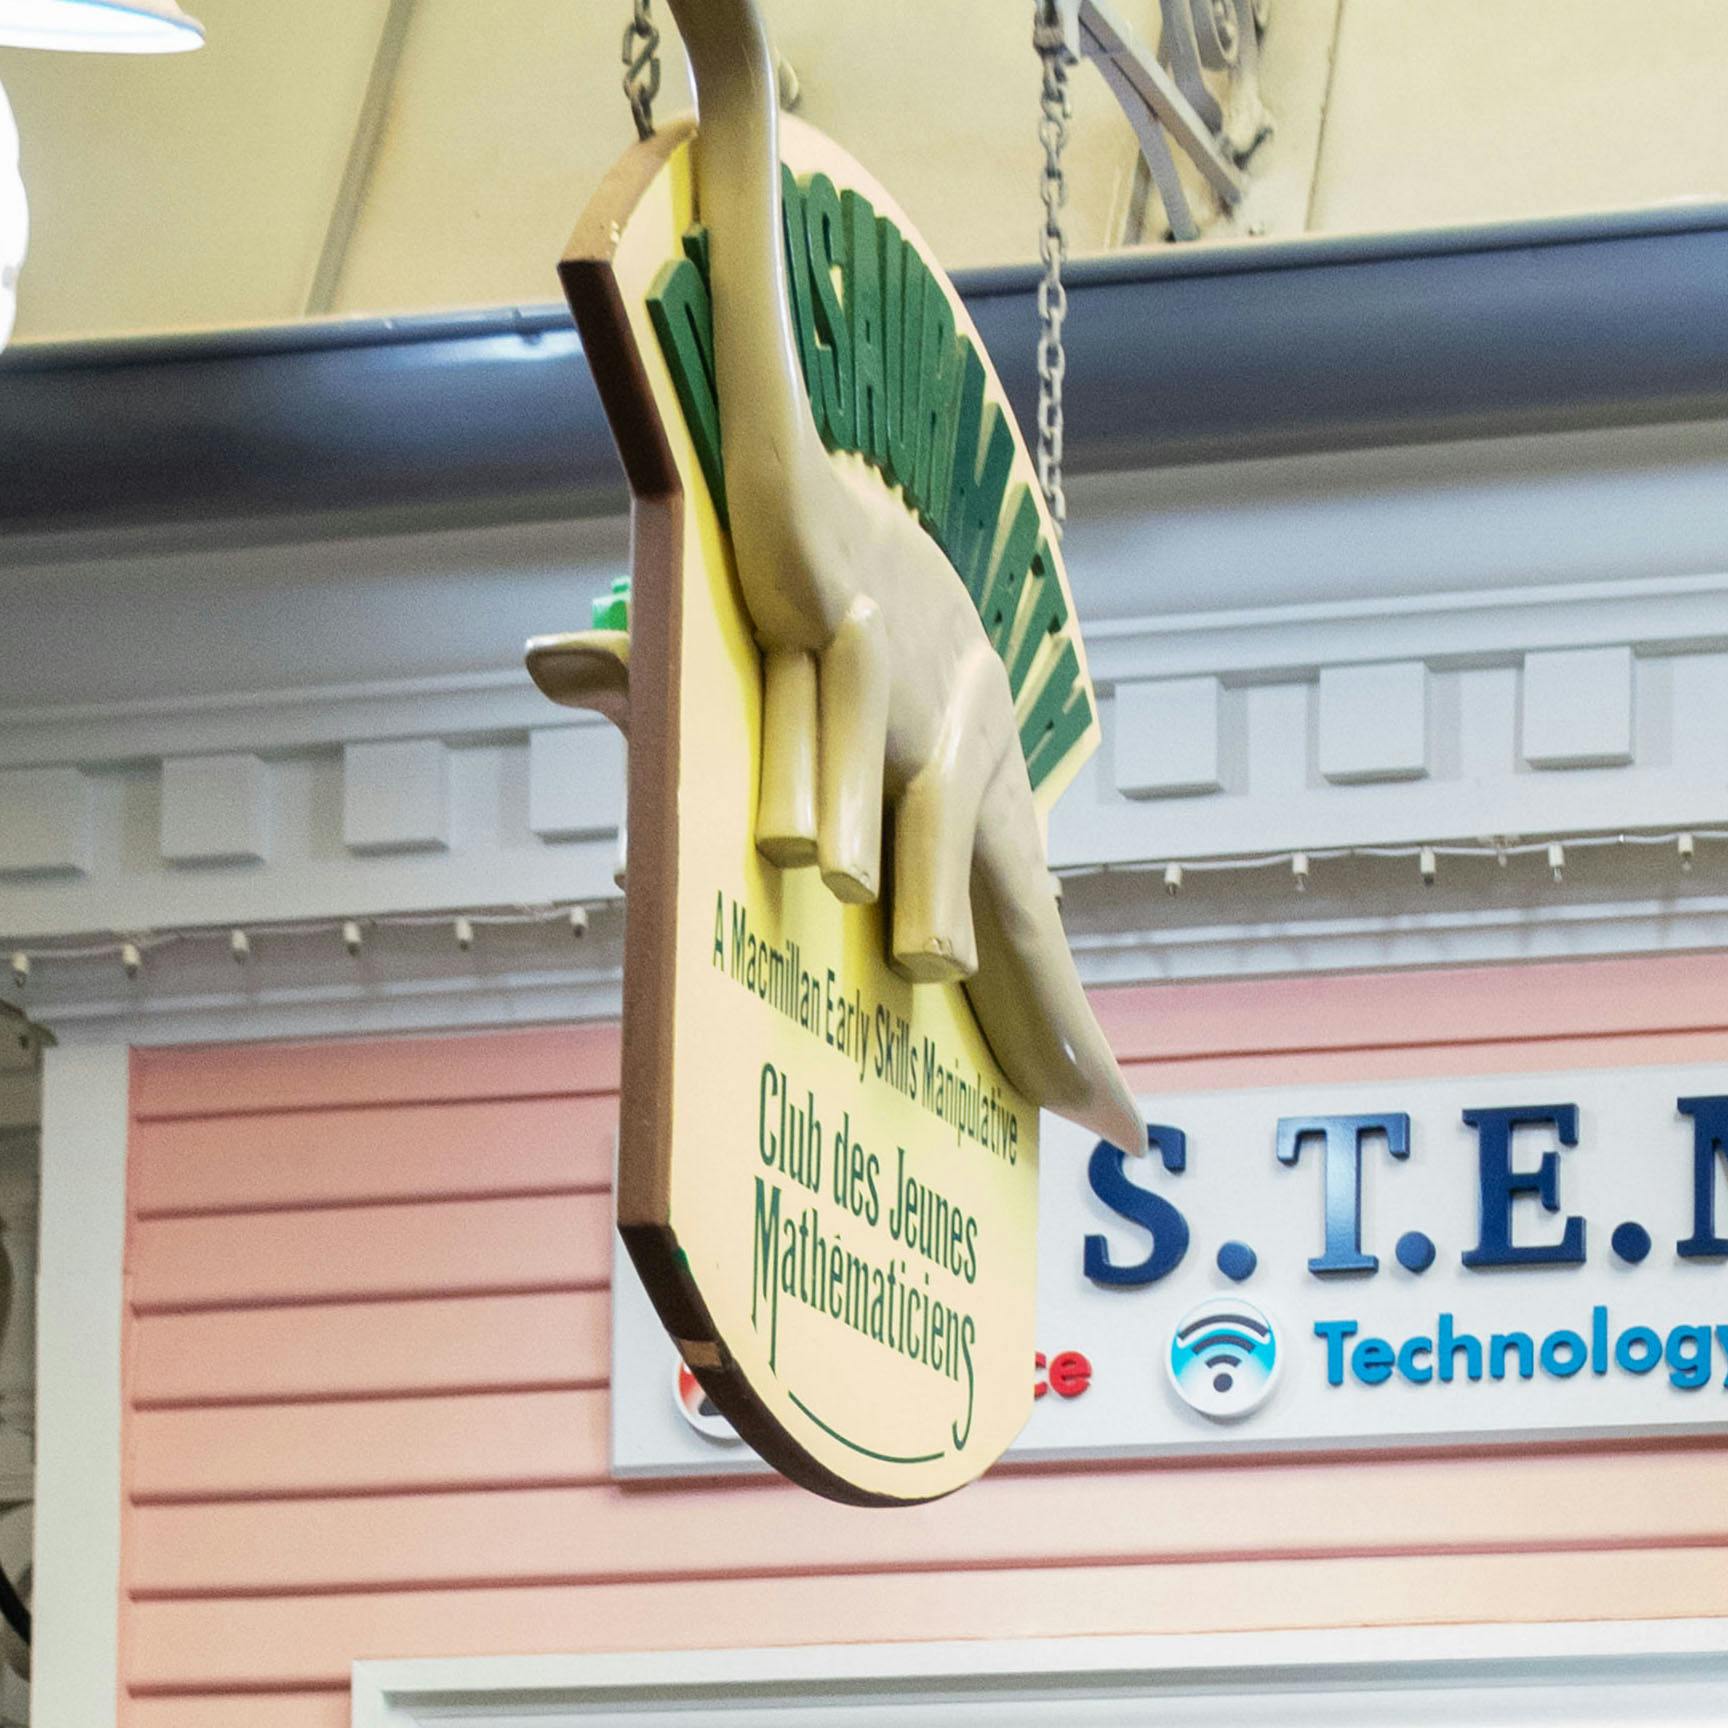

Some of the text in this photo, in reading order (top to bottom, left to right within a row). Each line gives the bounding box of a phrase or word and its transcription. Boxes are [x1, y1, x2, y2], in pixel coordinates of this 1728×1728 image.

[712, 889, 1018, 1167] A Macmillan Early Skills Manipulative
[758, 1062, 978, 1285] Club des Jeunes
[751, 1174, 977, 1451] Mathématiciens
